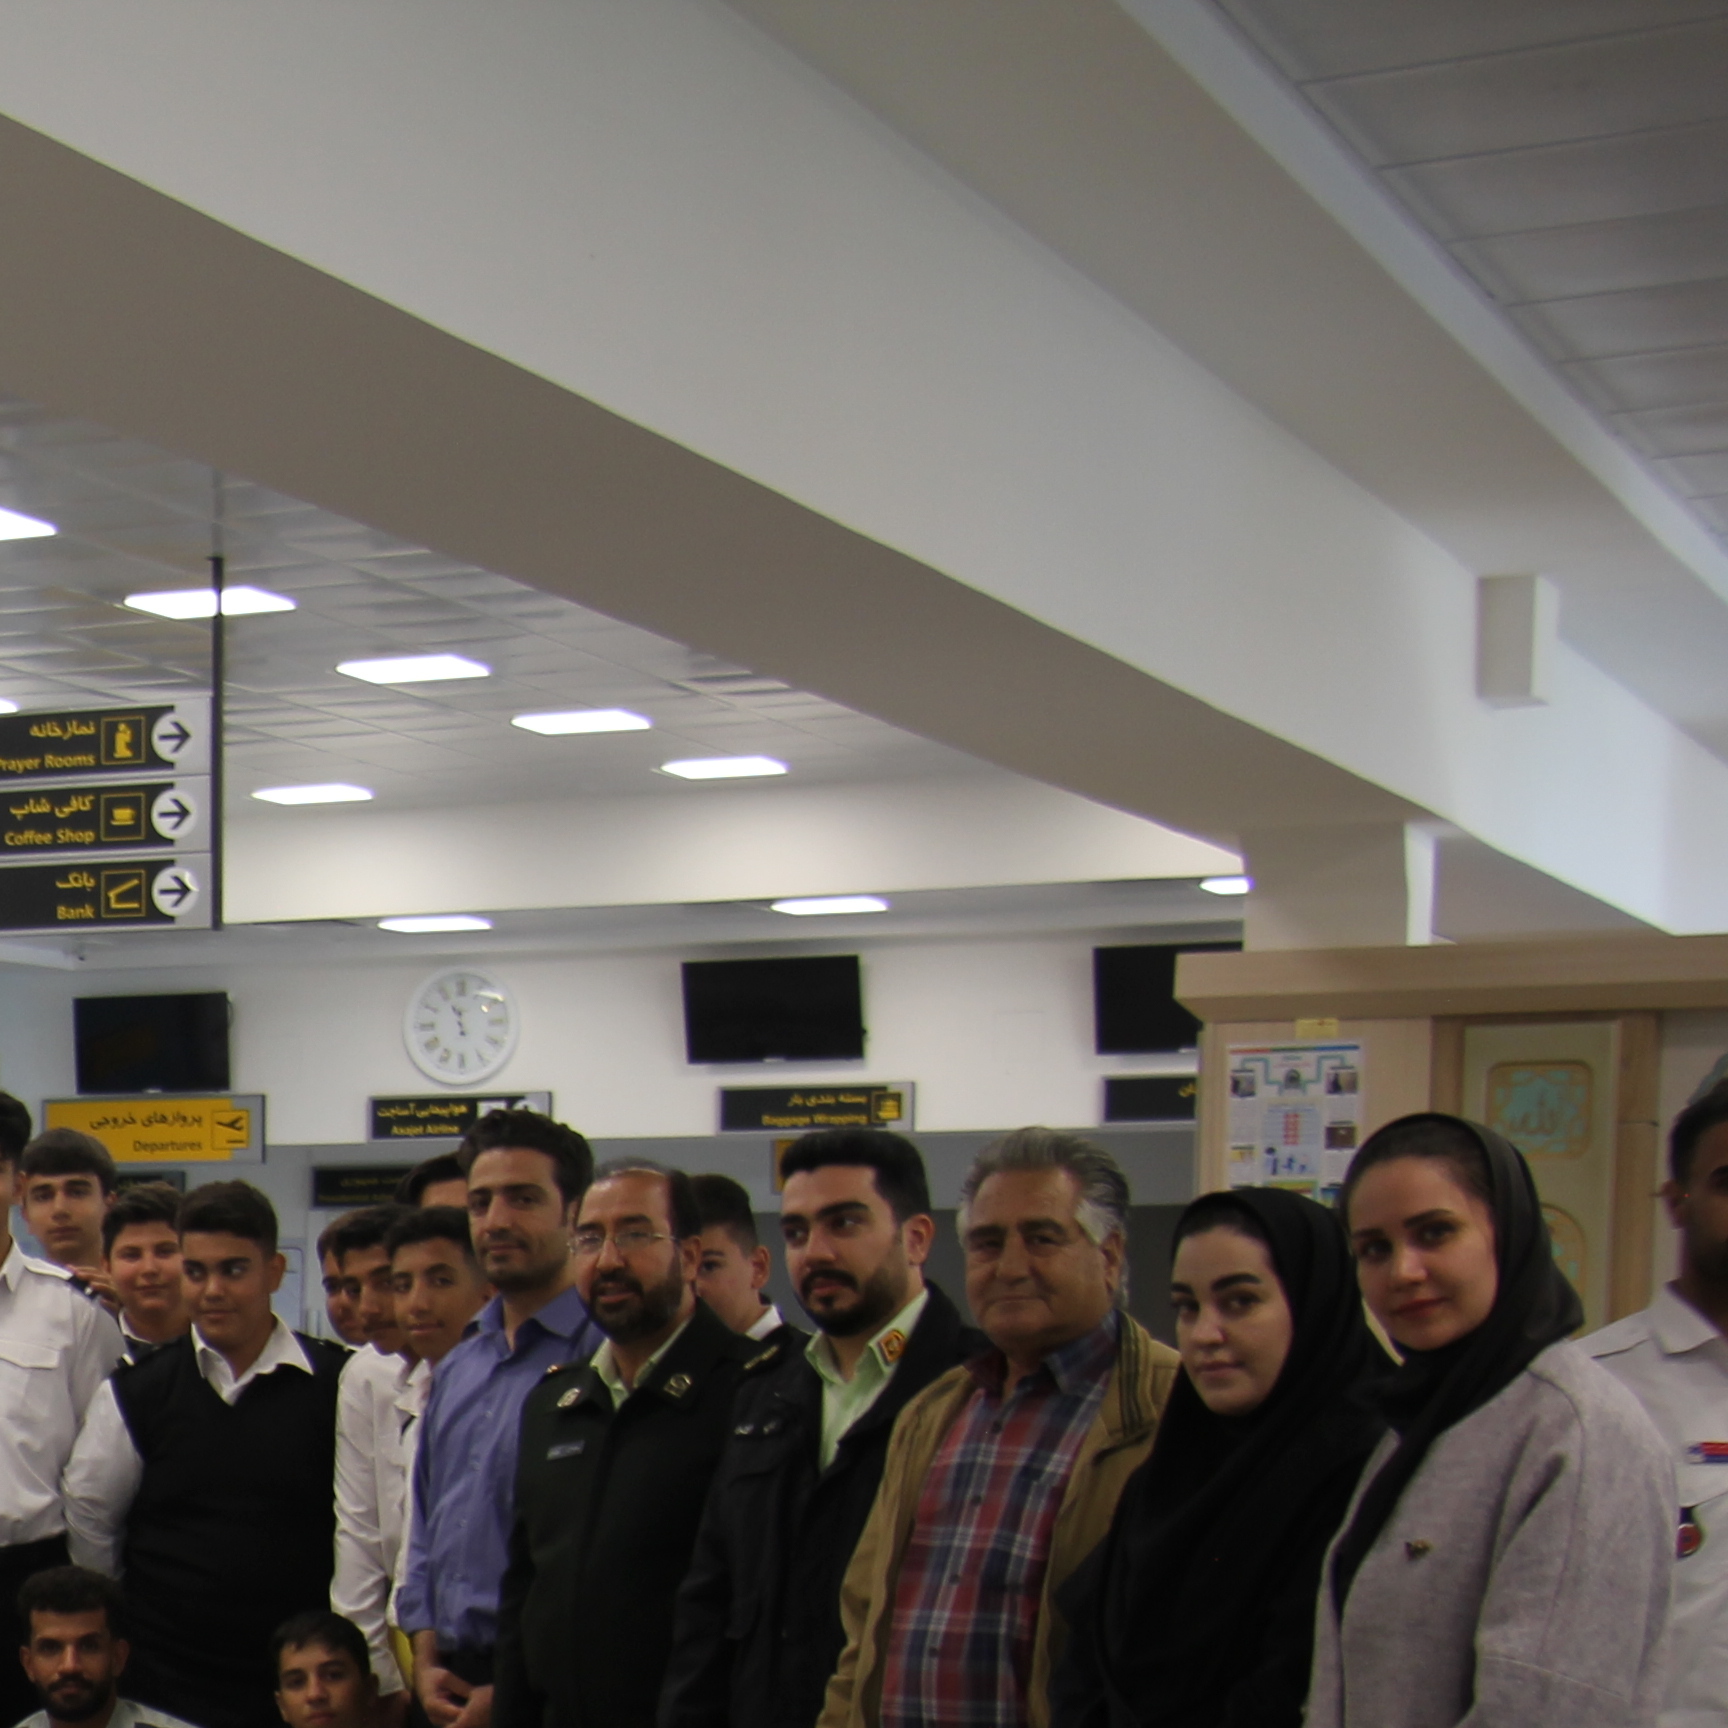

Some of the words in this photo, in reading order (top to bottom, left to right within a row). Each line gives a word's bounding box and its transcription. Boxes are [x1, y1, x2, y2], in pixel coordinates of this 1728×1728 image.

[29, 719, 96, 740] نمازخانه
[44, 754, 96, 769] Rooms
[9, 798, 52, 822] شاپ
[54, 795, 95, 819] کافی
[4, 829, 53, 847] Coffee
[56, 828, 95, 845] Shop
[55, 872, 96, 892] بانک
[56, 904, 95, 920] Bank
[89, 1112, 138, 1130] خروجی
[141, 1111, 203, 1128] پروازهای
[133, 1140, 203, 1154] Departures
